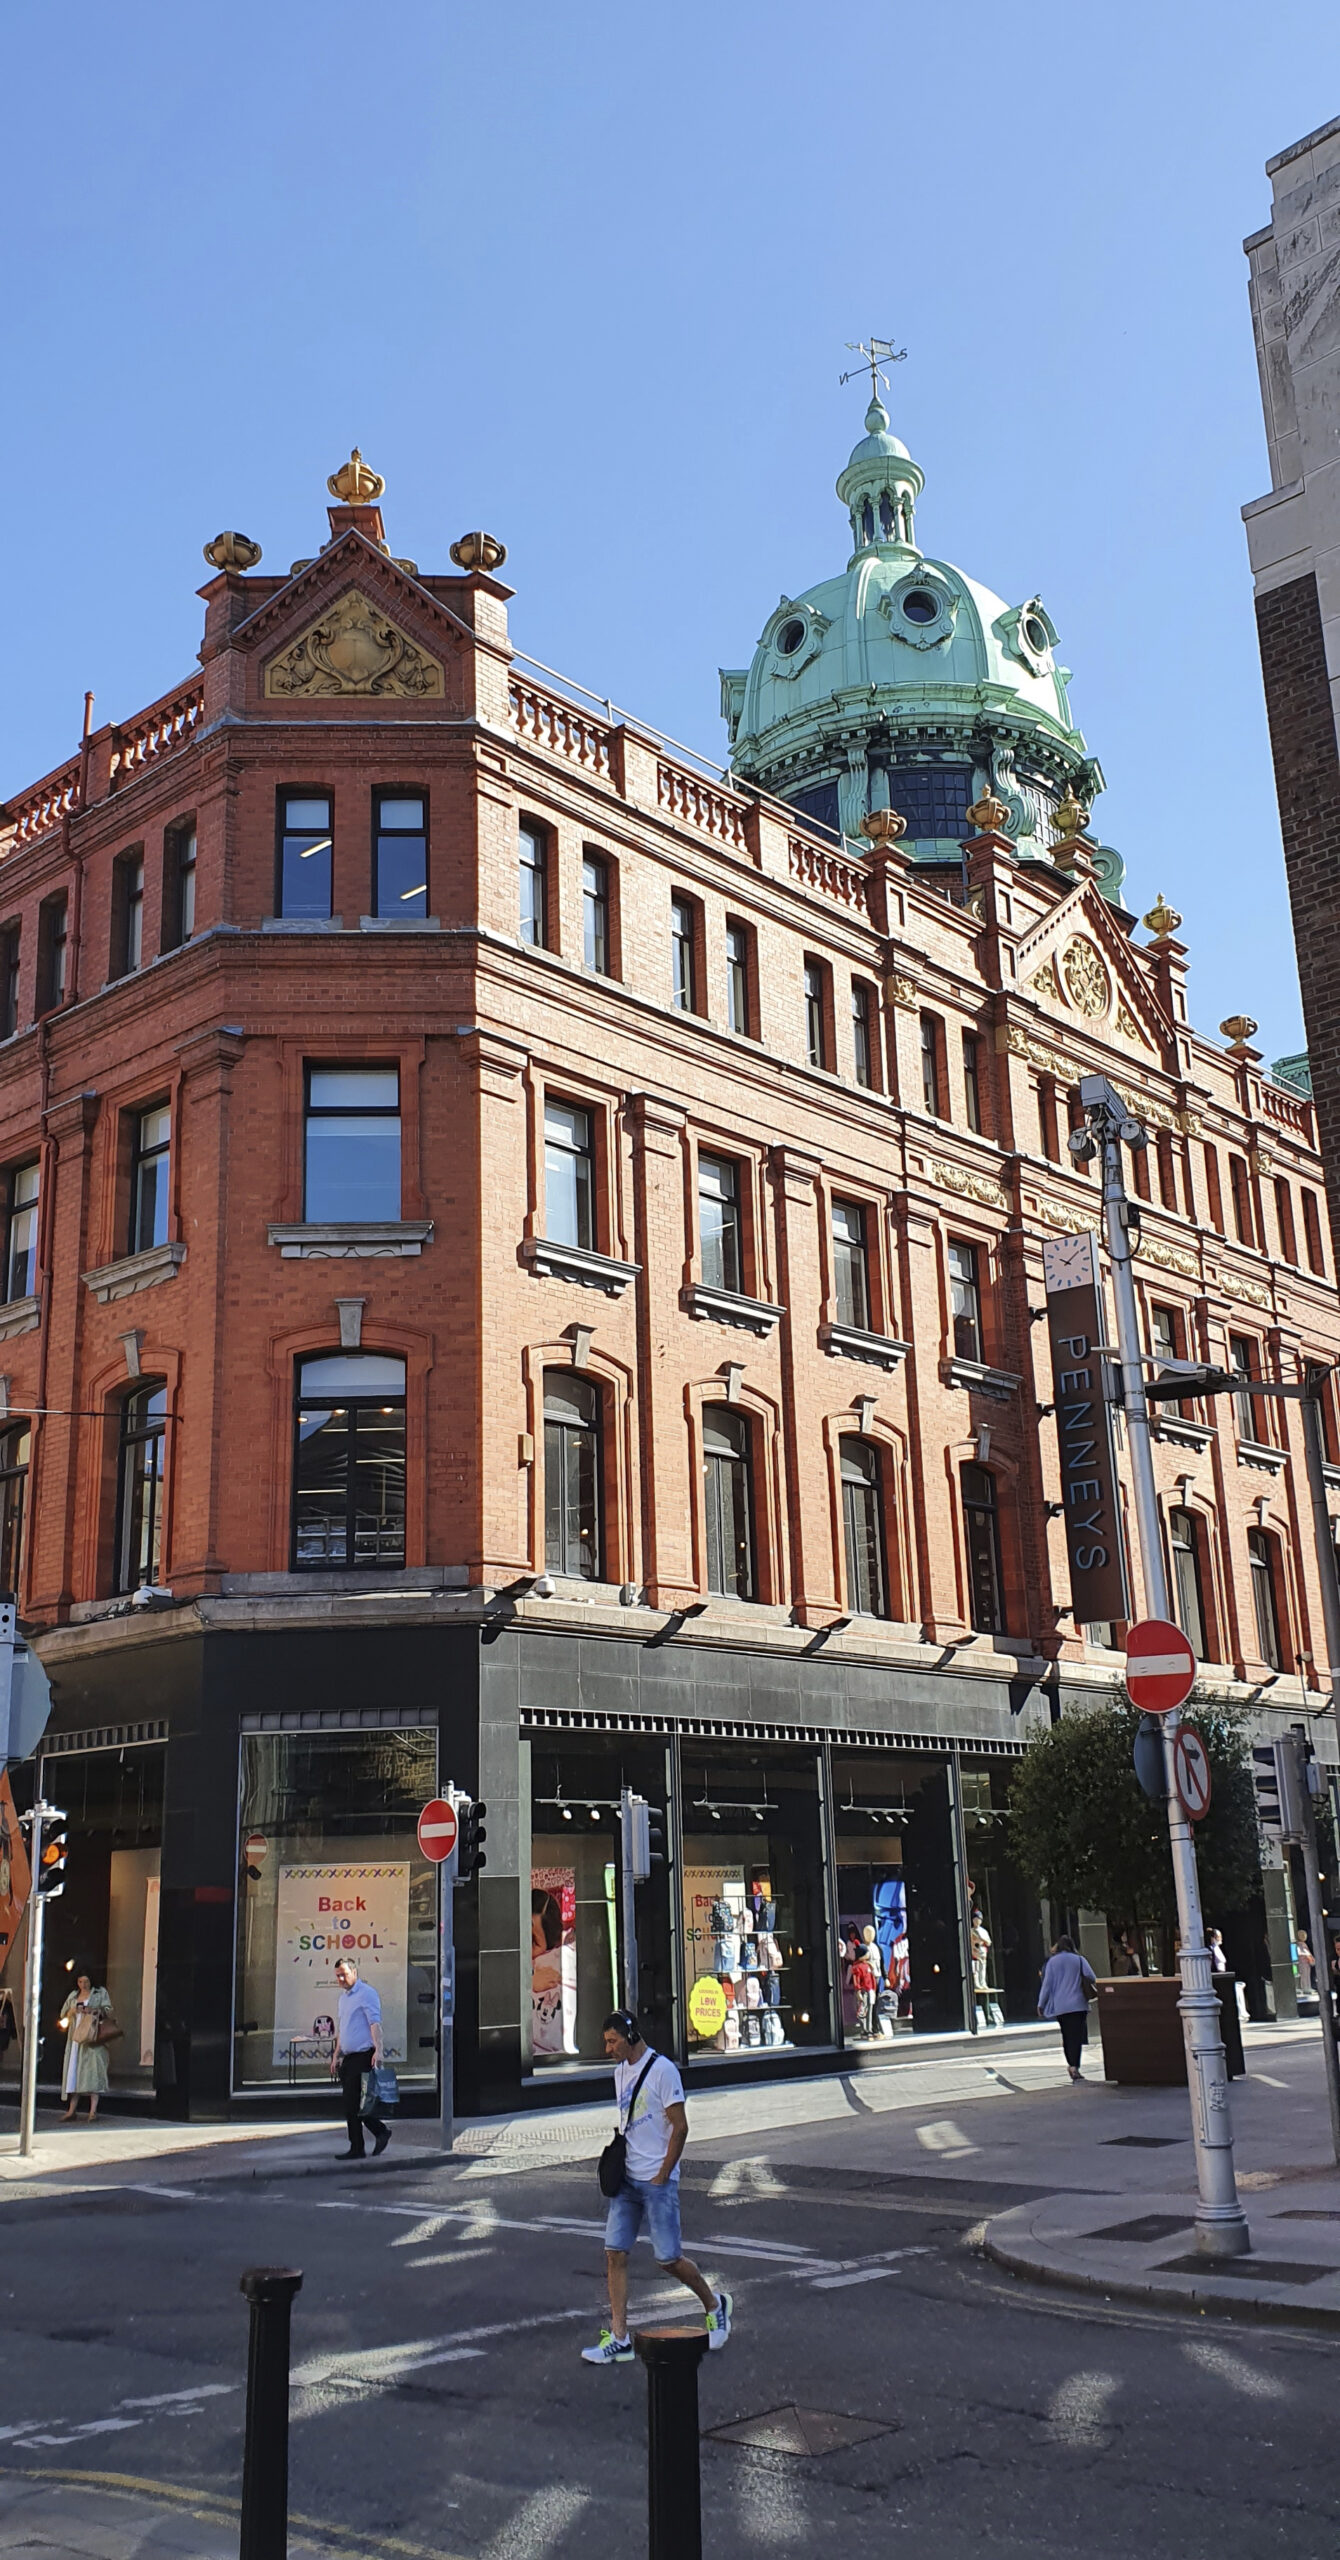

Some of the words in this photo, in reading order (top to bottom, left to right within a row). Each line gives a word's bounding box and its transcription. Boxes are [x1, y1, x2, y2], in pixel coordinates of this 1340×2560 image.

[1057, 1334, 1107, 1570] PENNEYS
[318, 1896, 367, 1912] Back
[332, 1917, 351, 1930] to
[299, 1934, 384, 1951] SCHOOL
[700, 1996, 717, 2006] LOW
[695, 2007, 722, 2018] PRICES
